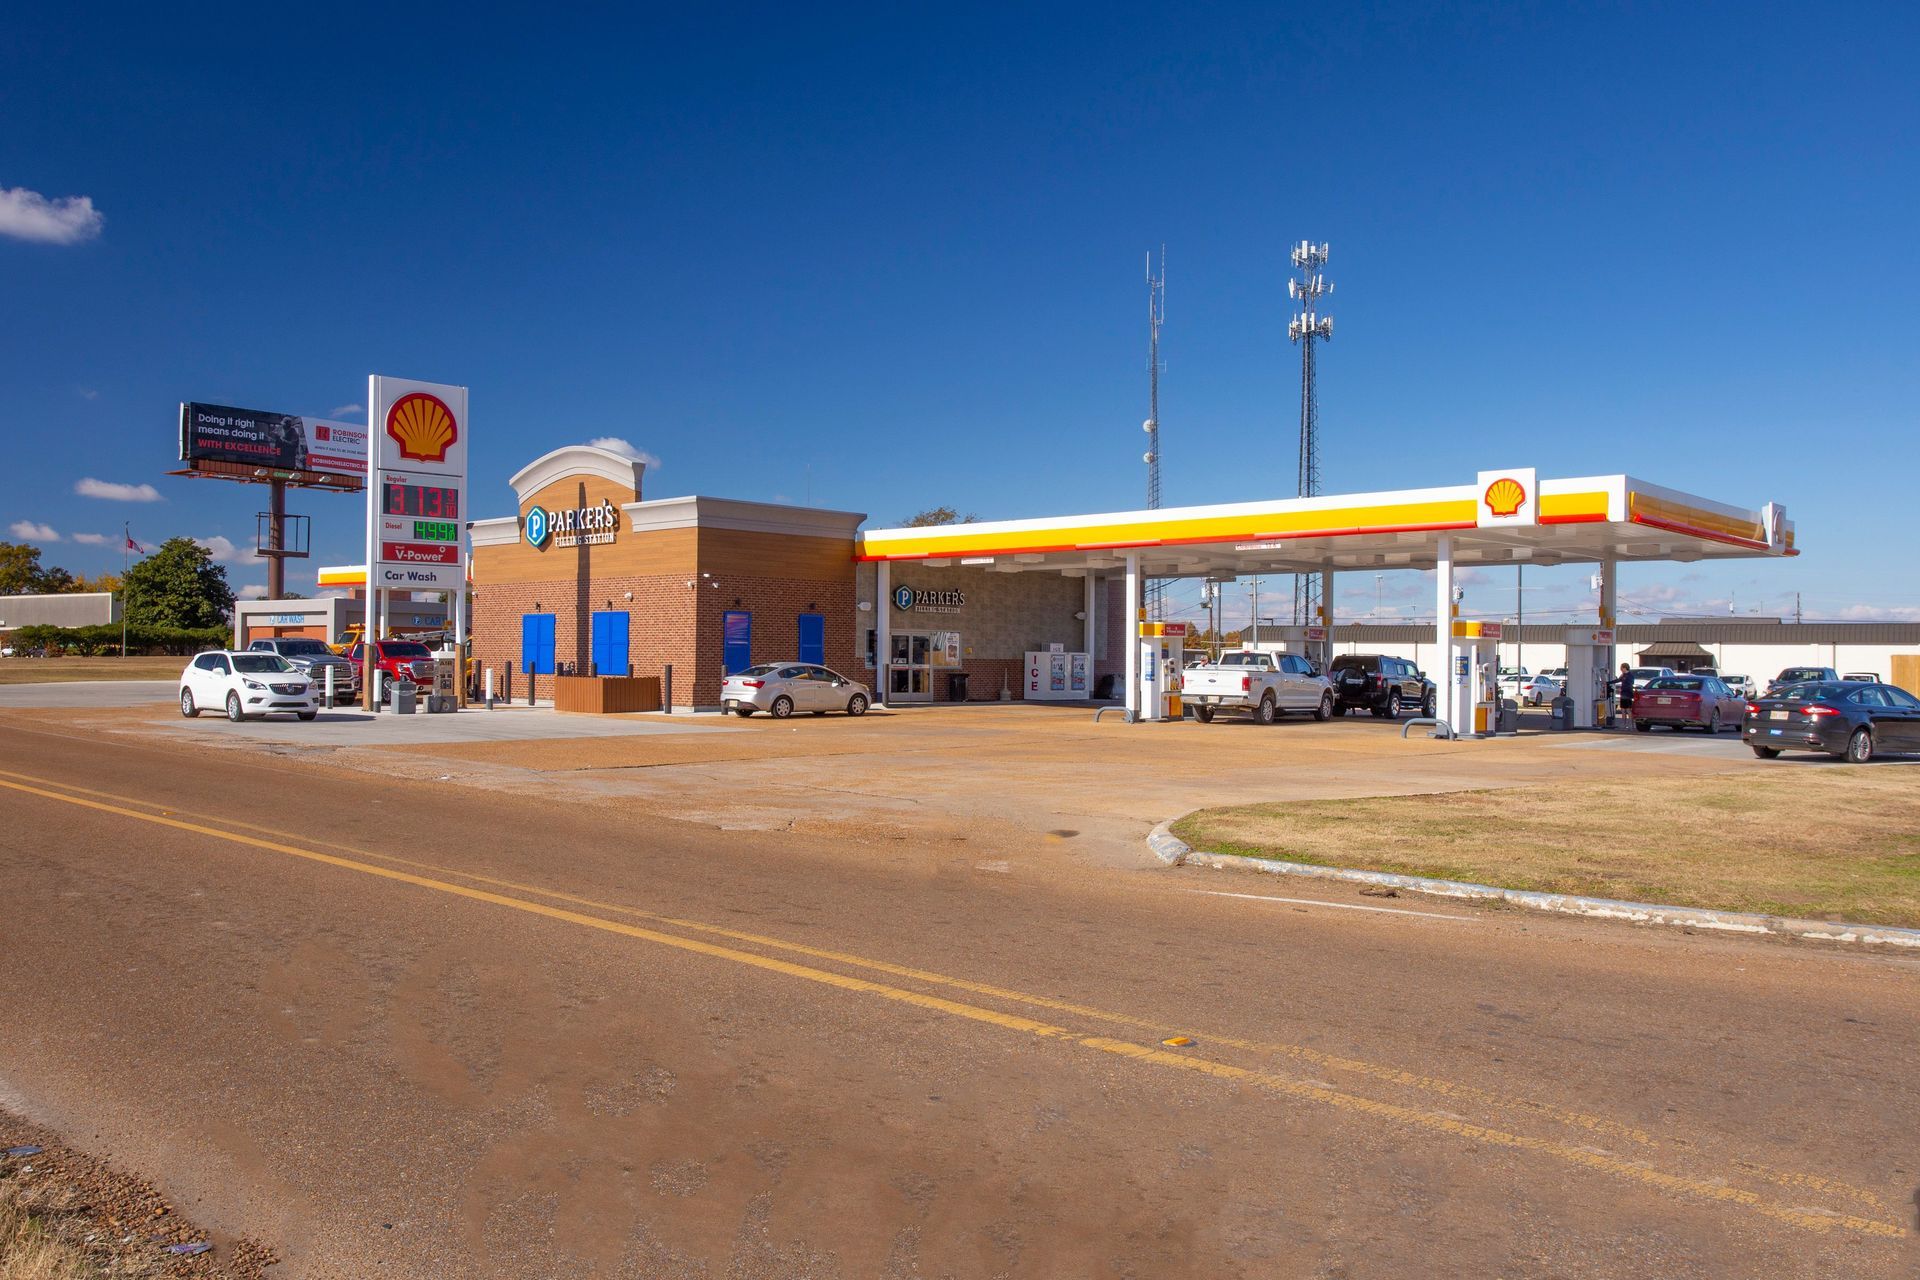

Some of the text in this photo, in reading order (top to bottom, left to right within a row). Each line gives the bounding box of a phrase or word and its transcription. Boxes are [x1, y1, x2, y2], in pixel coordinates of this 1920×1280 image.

[198, 413, 225, 426] Doing
[235, 419, 255, 429] right
[198, 426, 265, 441] means doing it
[332, 428, 368, 440] ROBINSON
[332, 435, 361, 445] ELECTRIC
[198, 439, 282, 456] WITH EXCELLENCE
[386, 474, 407, 483] Regular
[548, 498, 614, 533] PARKER'S
[385, 522, 402, 530] Diesel
[555, 532, 614, 547] FILLING STATION
[395, 549, 444, 561] V-Power
[385, 570, 437, 582] Car Wash
[915, 590, 966, 606] PARKER'S
[915, 605, 961, 614] FILLING STATION
[288, 613, 304, 623] WASH
[1031, 655, 1039, 691] ICE
